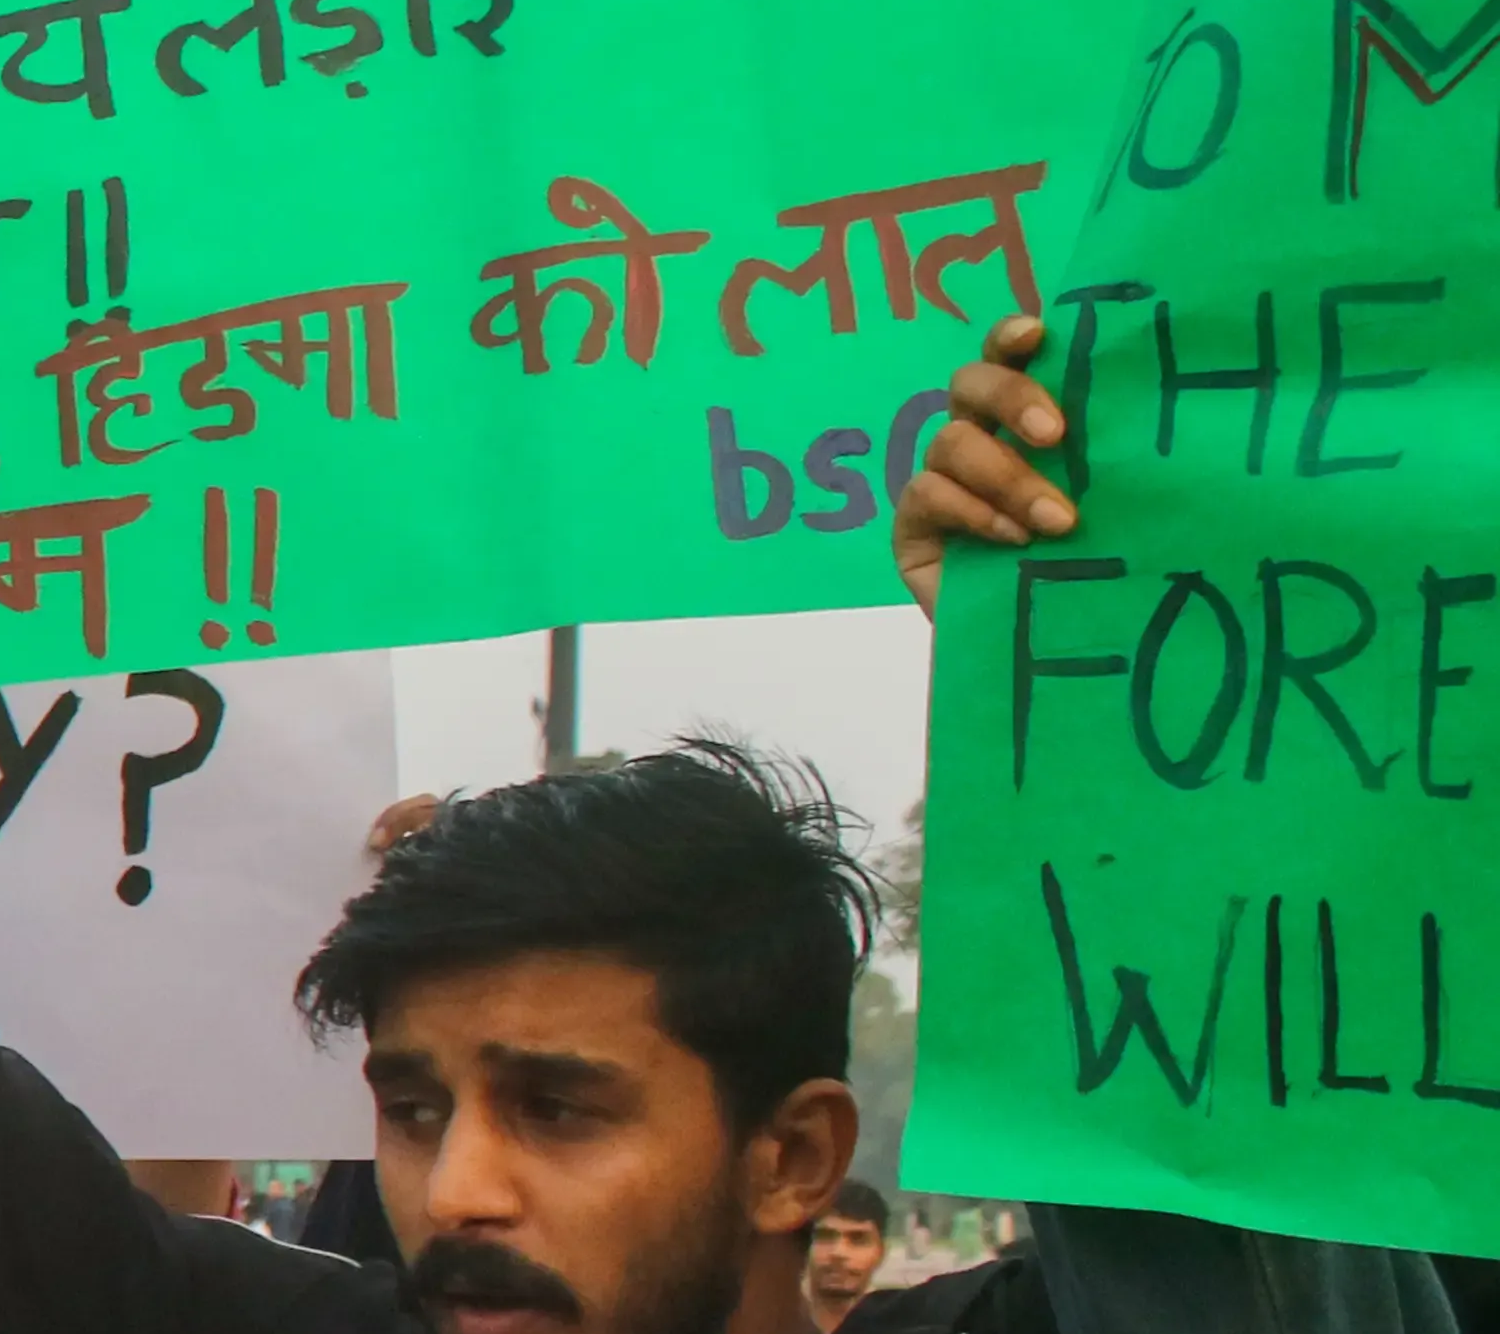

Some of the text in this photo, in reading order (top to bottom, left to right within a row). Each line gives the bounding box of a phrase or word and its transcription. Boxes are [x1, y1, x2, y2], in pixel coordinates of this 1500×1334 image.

[469, 175, 712, 375] को
[717, 159, 1048, 357] लाल
[1054, 277, 1445, 499] THE
